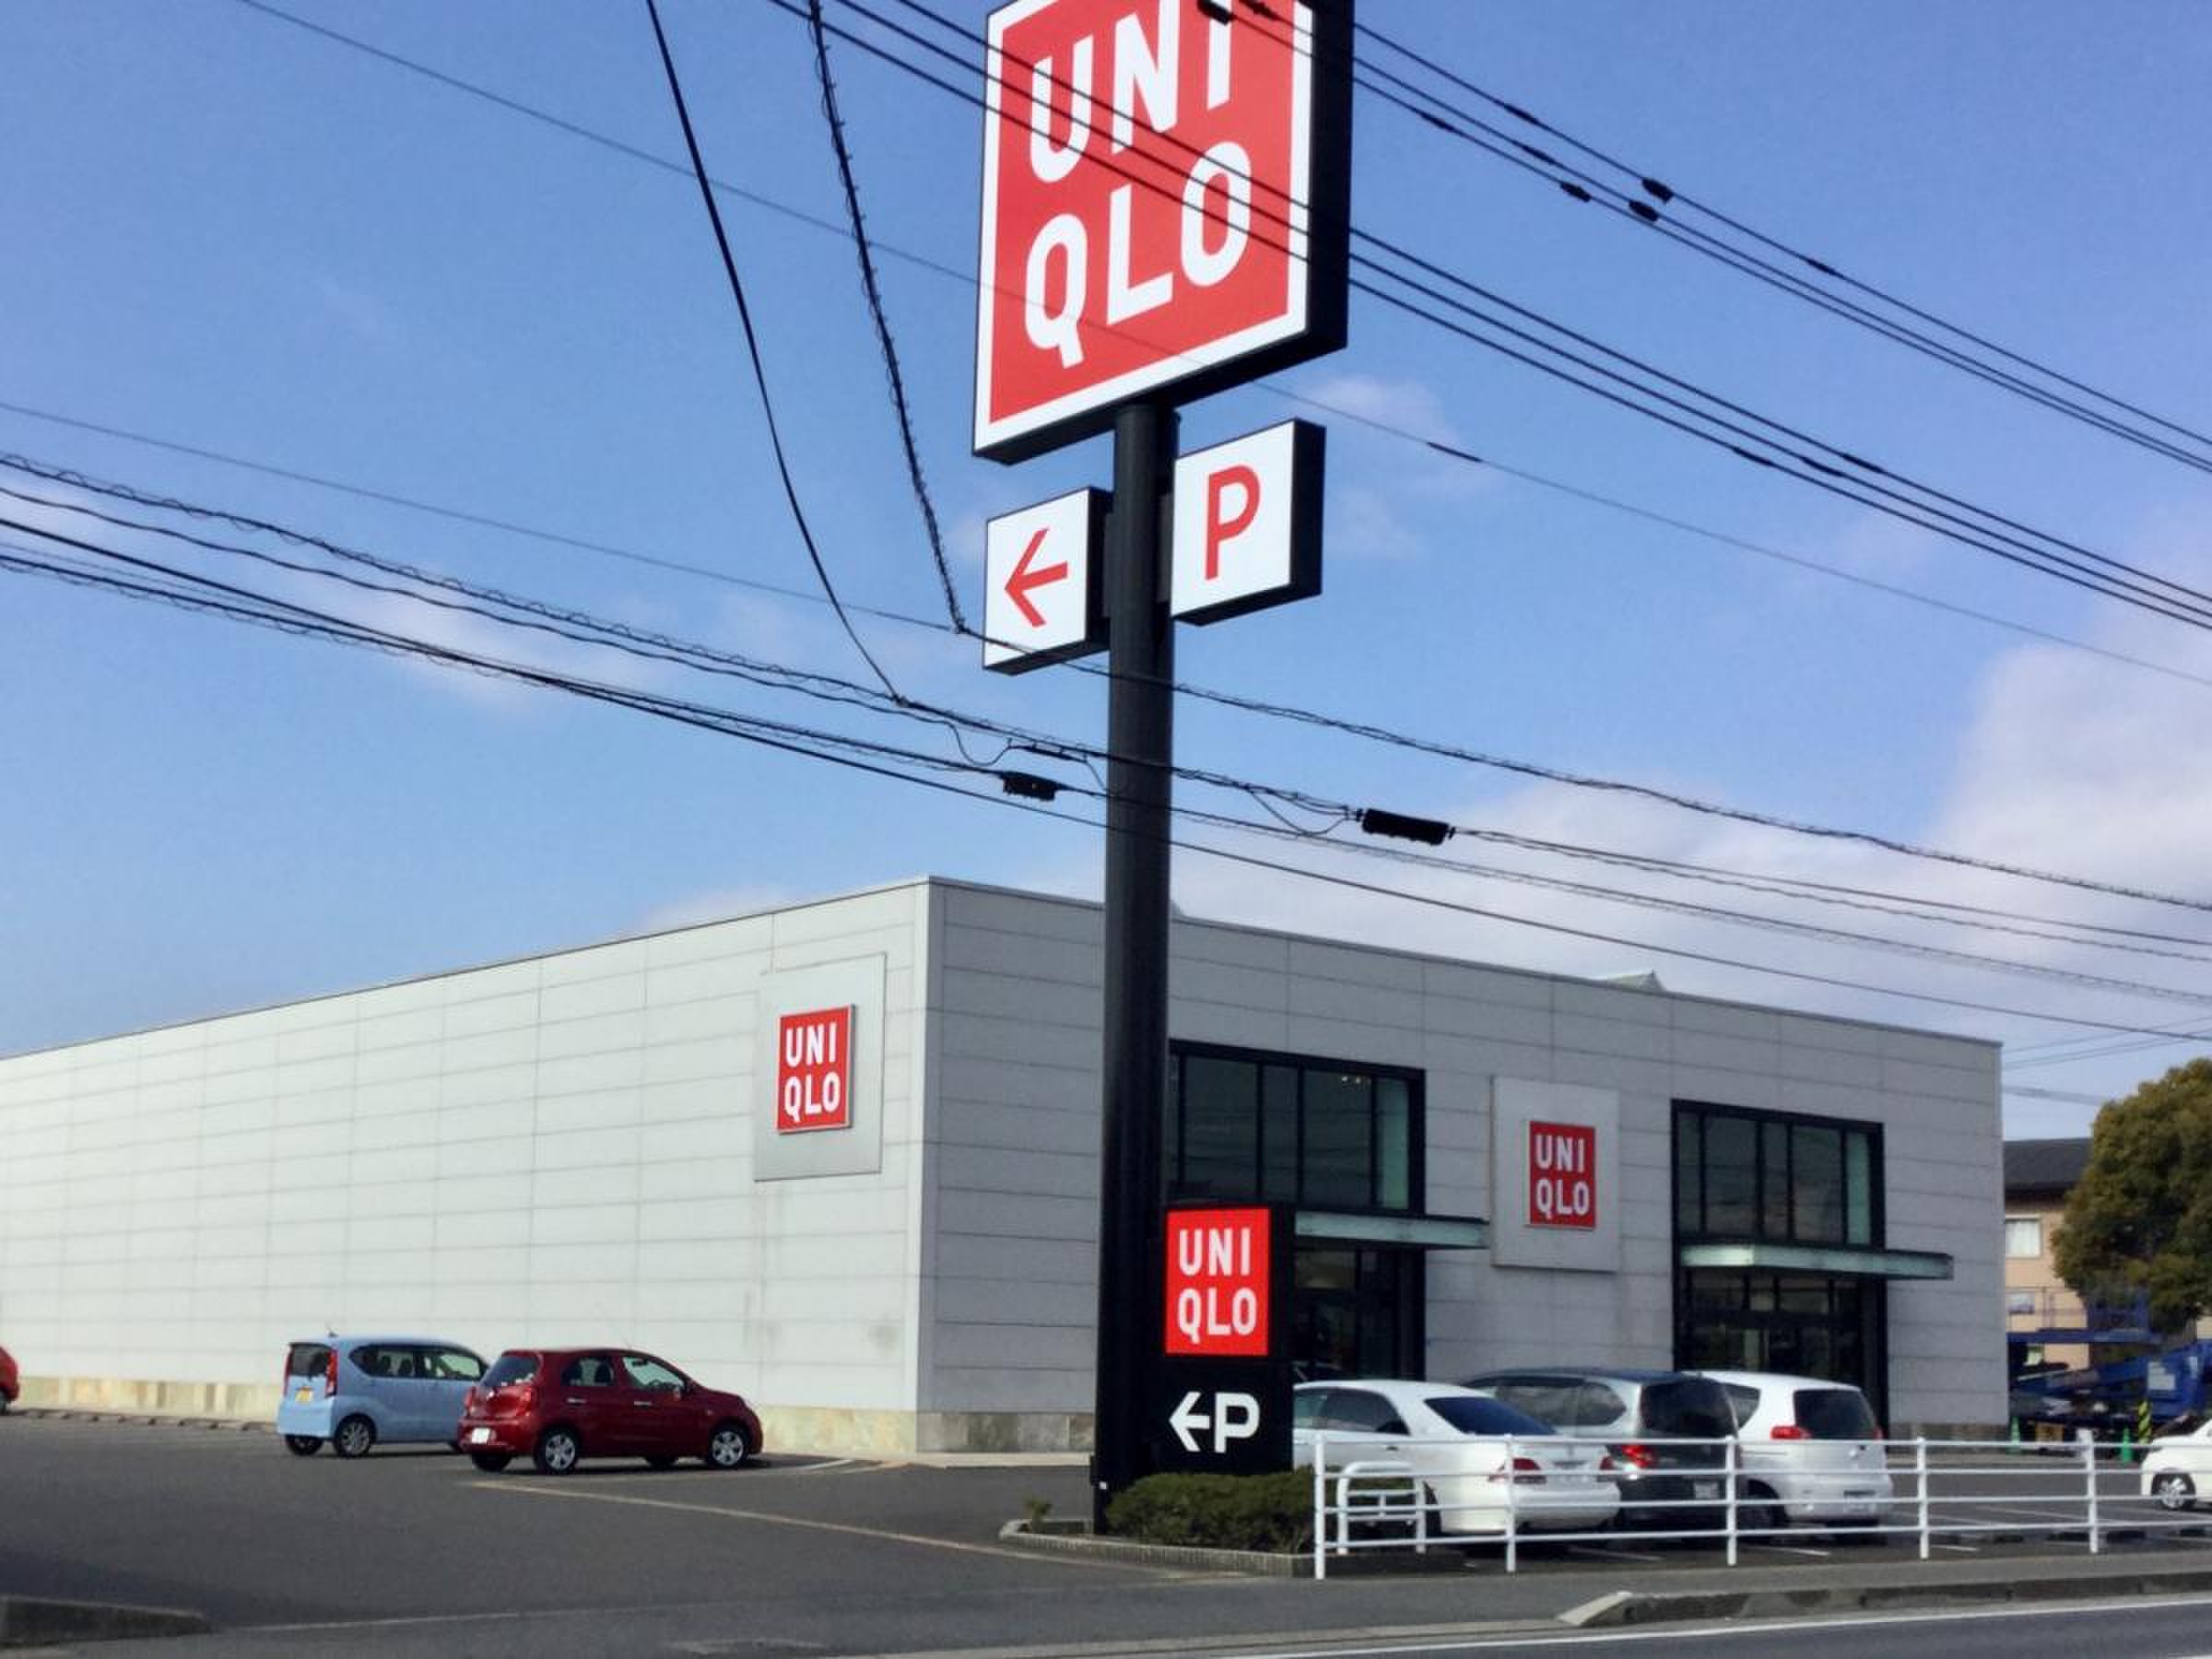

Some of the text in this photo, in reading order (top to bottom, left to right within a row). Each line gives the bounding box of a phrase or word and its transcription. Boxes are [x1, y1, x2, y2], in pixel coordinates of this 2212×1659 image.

[1030, 0, 1232, 183] UNI
[1025, 141, 1252, 370] QLO
[1206, 465, 1261, 581] P
[786, 1022, 837, 1067] UNI
[784, 1071, 841, 1123] QLO
[1536, 1135, 1585, 1173] UNI
[1535, 1177, 1590, 1220] QLO
[1179, 1228, 1251, 1277] UNI
[1177, 1287, 1257, 1345] QLO
[1214, 1392, 1261, 1453] P
